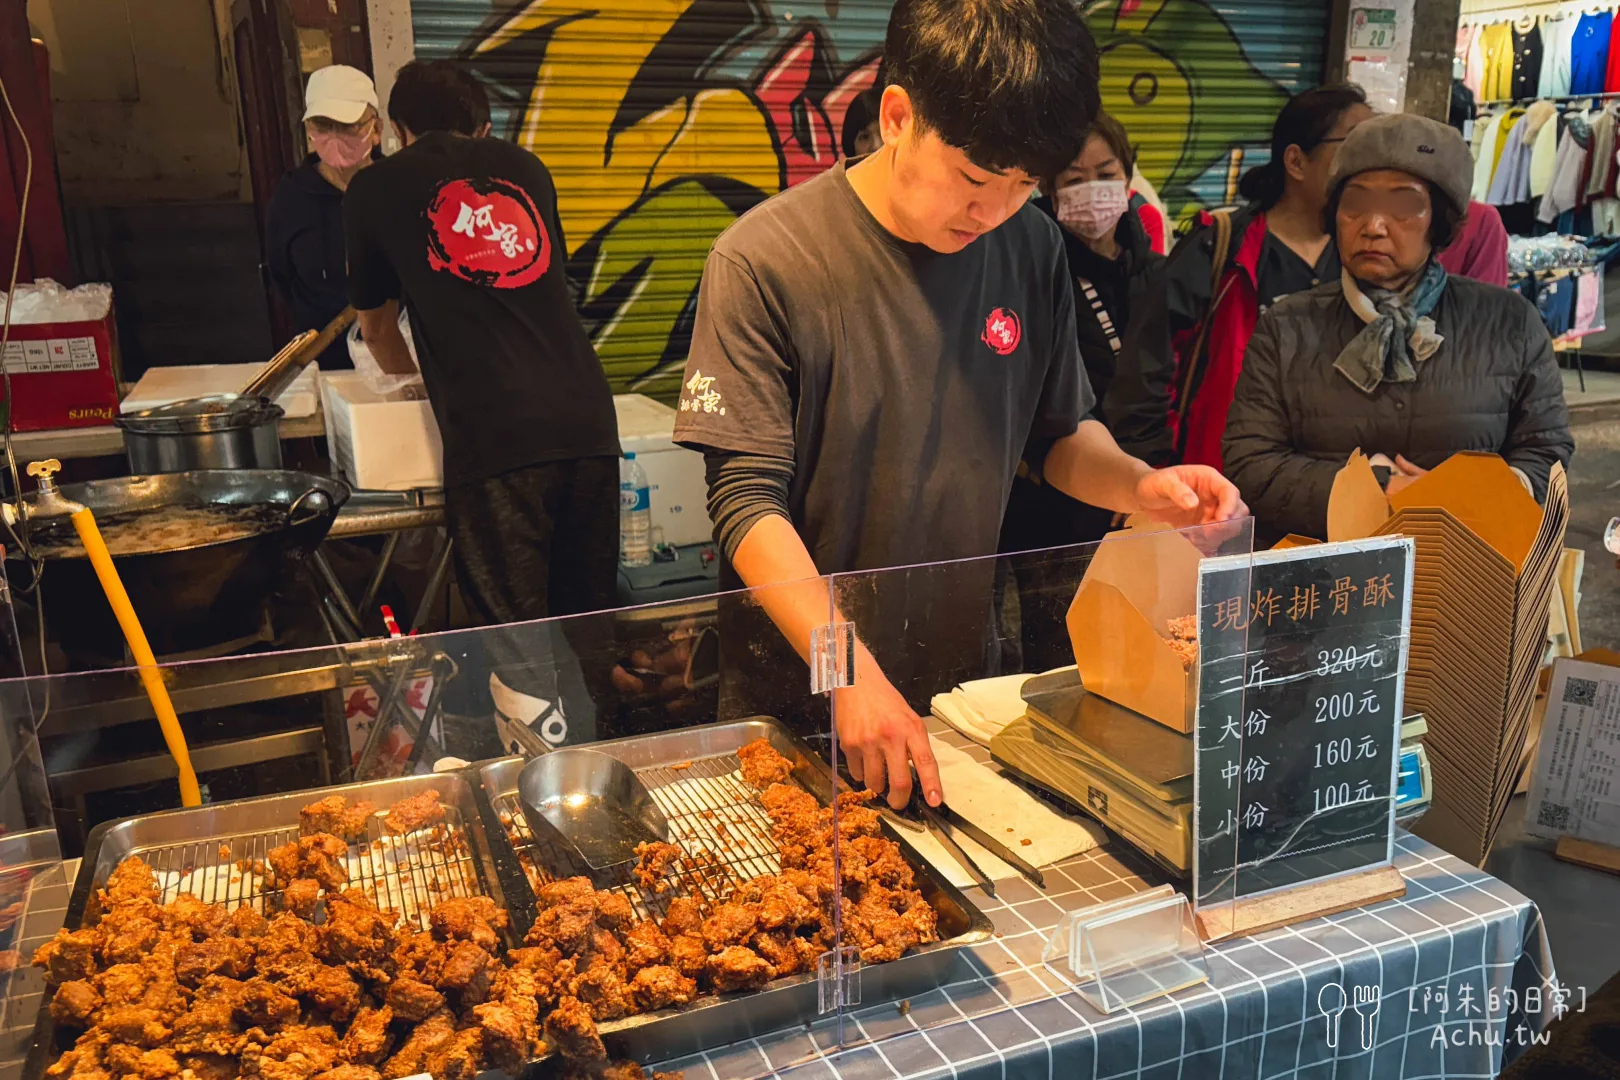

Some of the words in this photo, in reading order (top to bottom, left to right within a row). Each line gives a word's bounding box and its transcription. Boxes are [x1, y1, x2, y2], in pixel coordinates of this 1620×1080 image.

[1369, 30, 1386, 46] 20
[69, 407, 113, 419] Pears
[1212, 573, 1395, 632] 現炸排骨酥
[1219, 659, 1270, 690] 一斤
[1317, 643, 1383, 677] 320元
[1217, 708, 1271, 743] 大份
[1314, 689, 1380, 723] 200元
[1220, 755, 1270, 789] 中份
[1313, 734, 1377, 769] 160元
[1217, 801, 1269, 836] 小份
[1312, 779, 1375, 814] 100元
